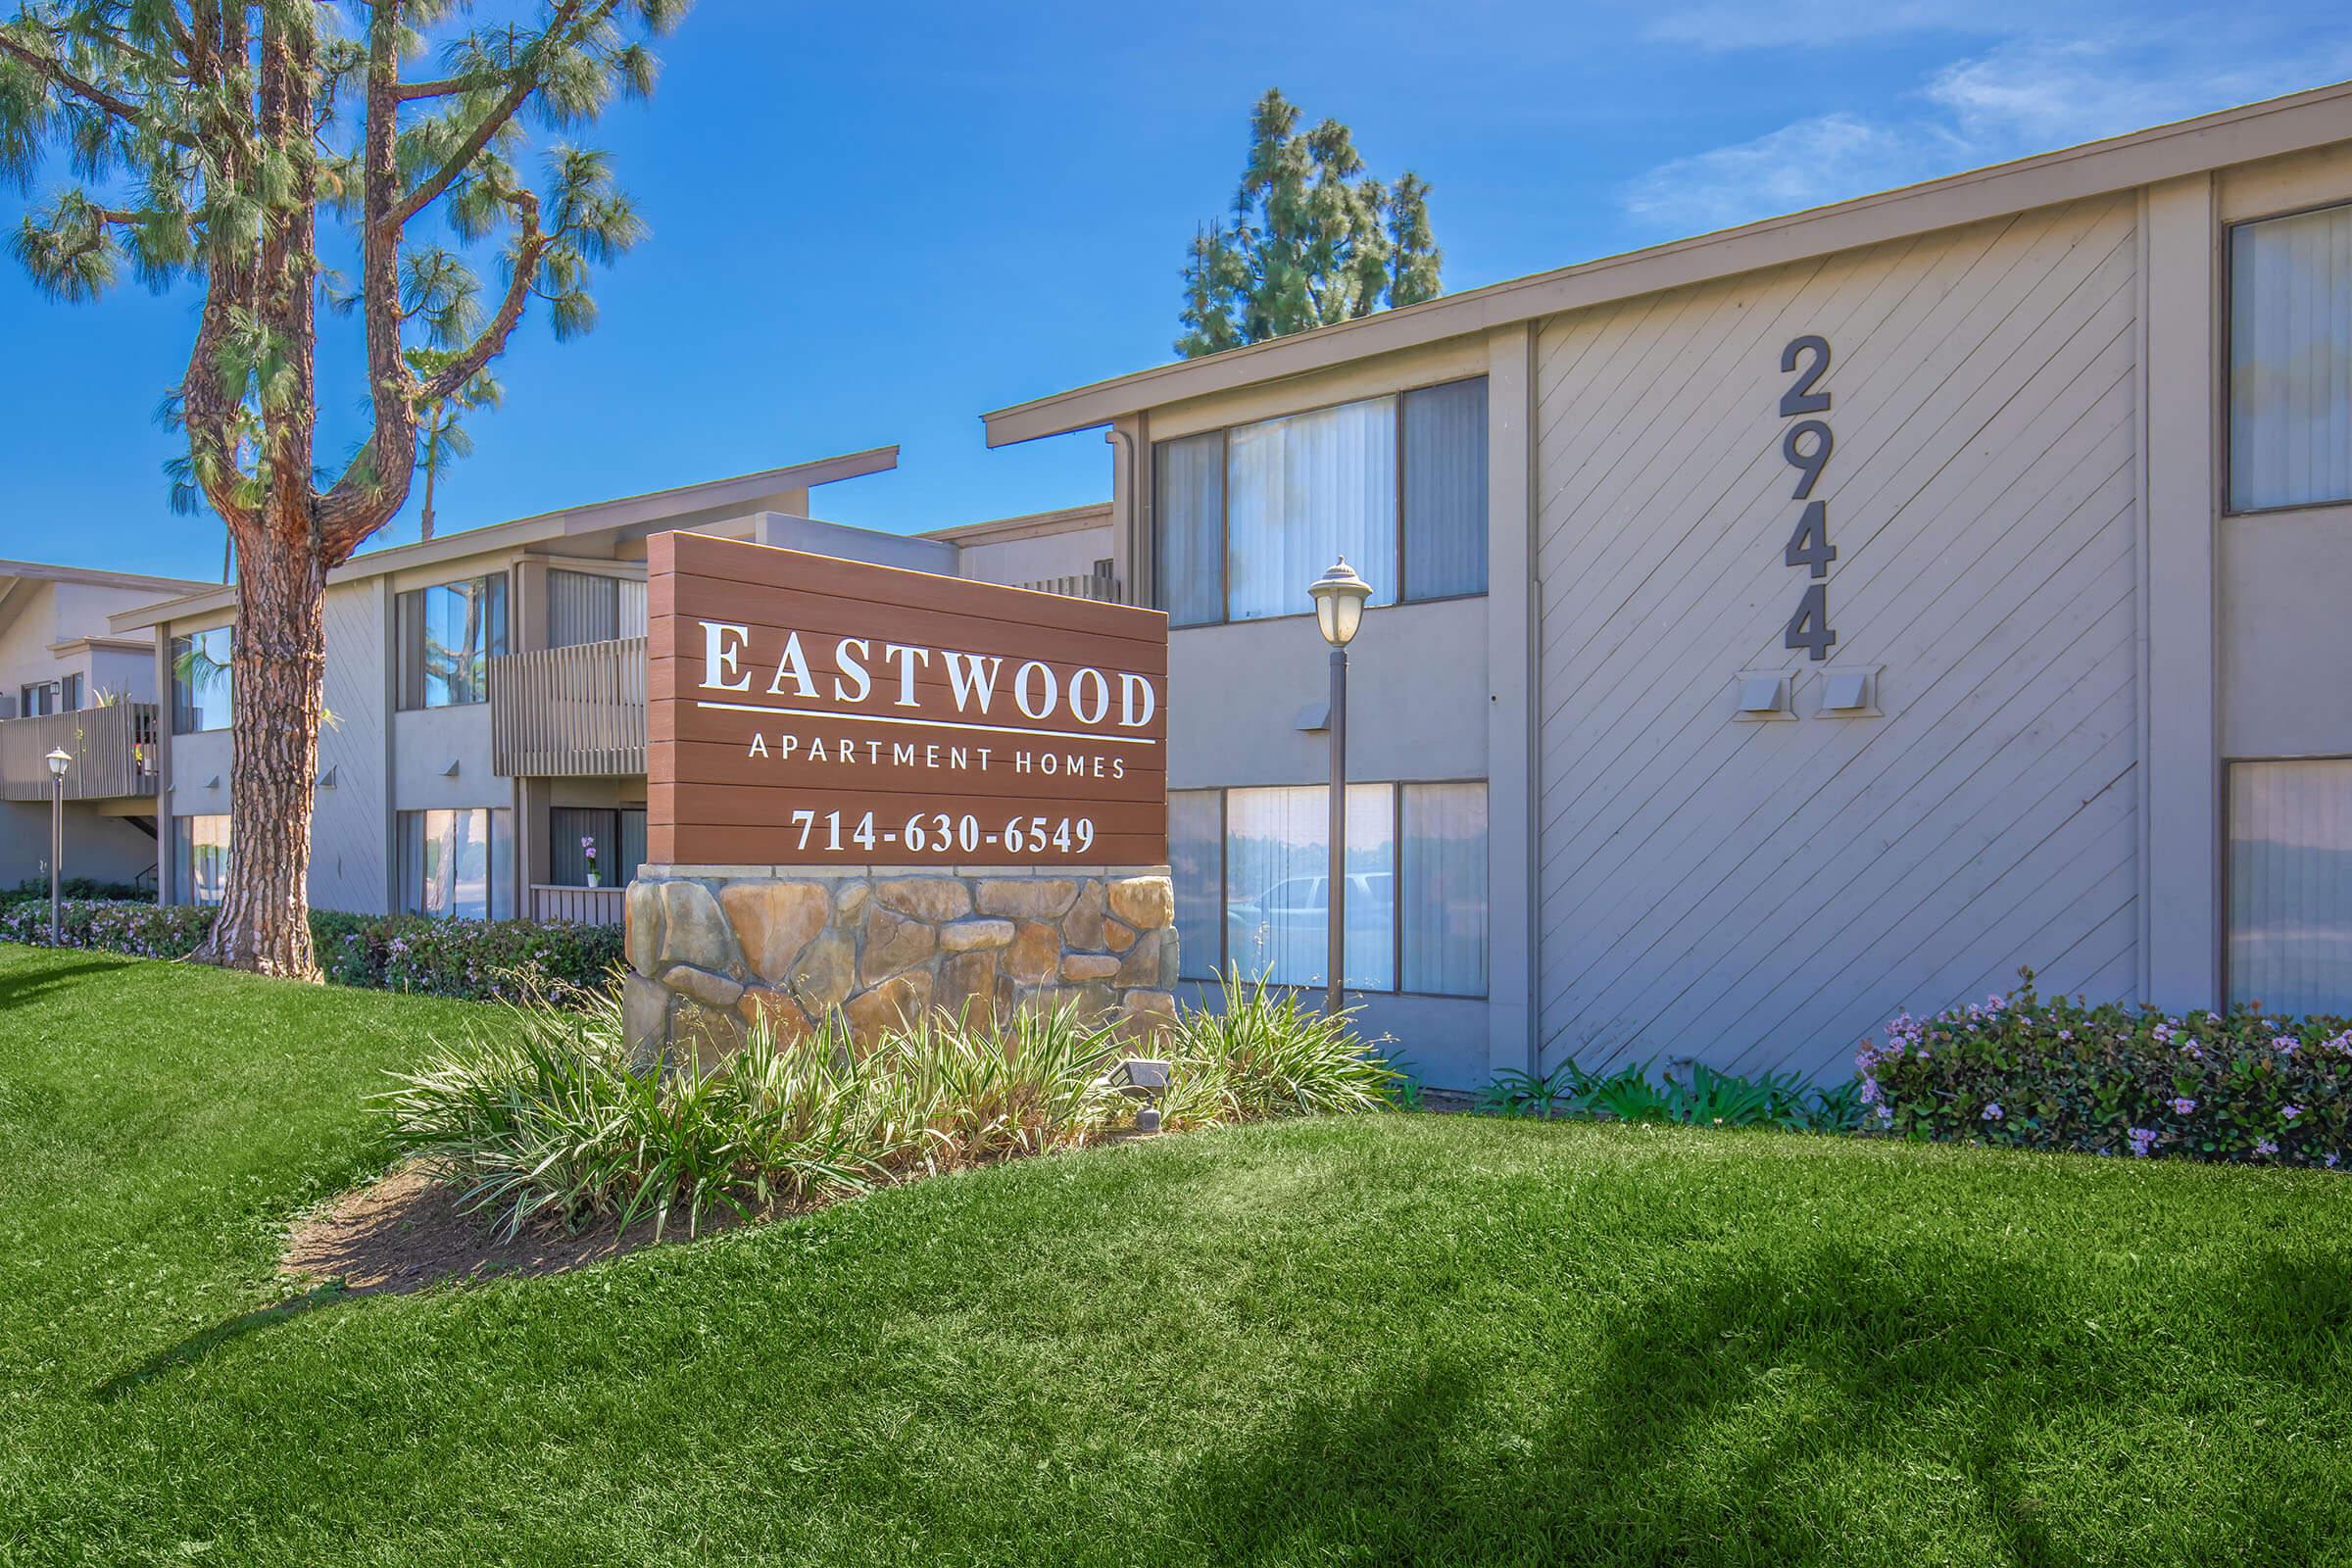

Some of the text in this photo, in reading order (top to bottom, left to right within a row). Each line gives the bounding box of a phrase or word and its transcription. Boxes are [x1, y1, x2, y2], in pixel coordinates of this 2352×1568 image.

[1780, 335, 1837, 662] 2944
[698, 621, 1155, 727] EASTWOOD
[748, 732, 1124, 779] APARTMENT HOMES
[791, 809, 1095, 854] 714-630-6549
